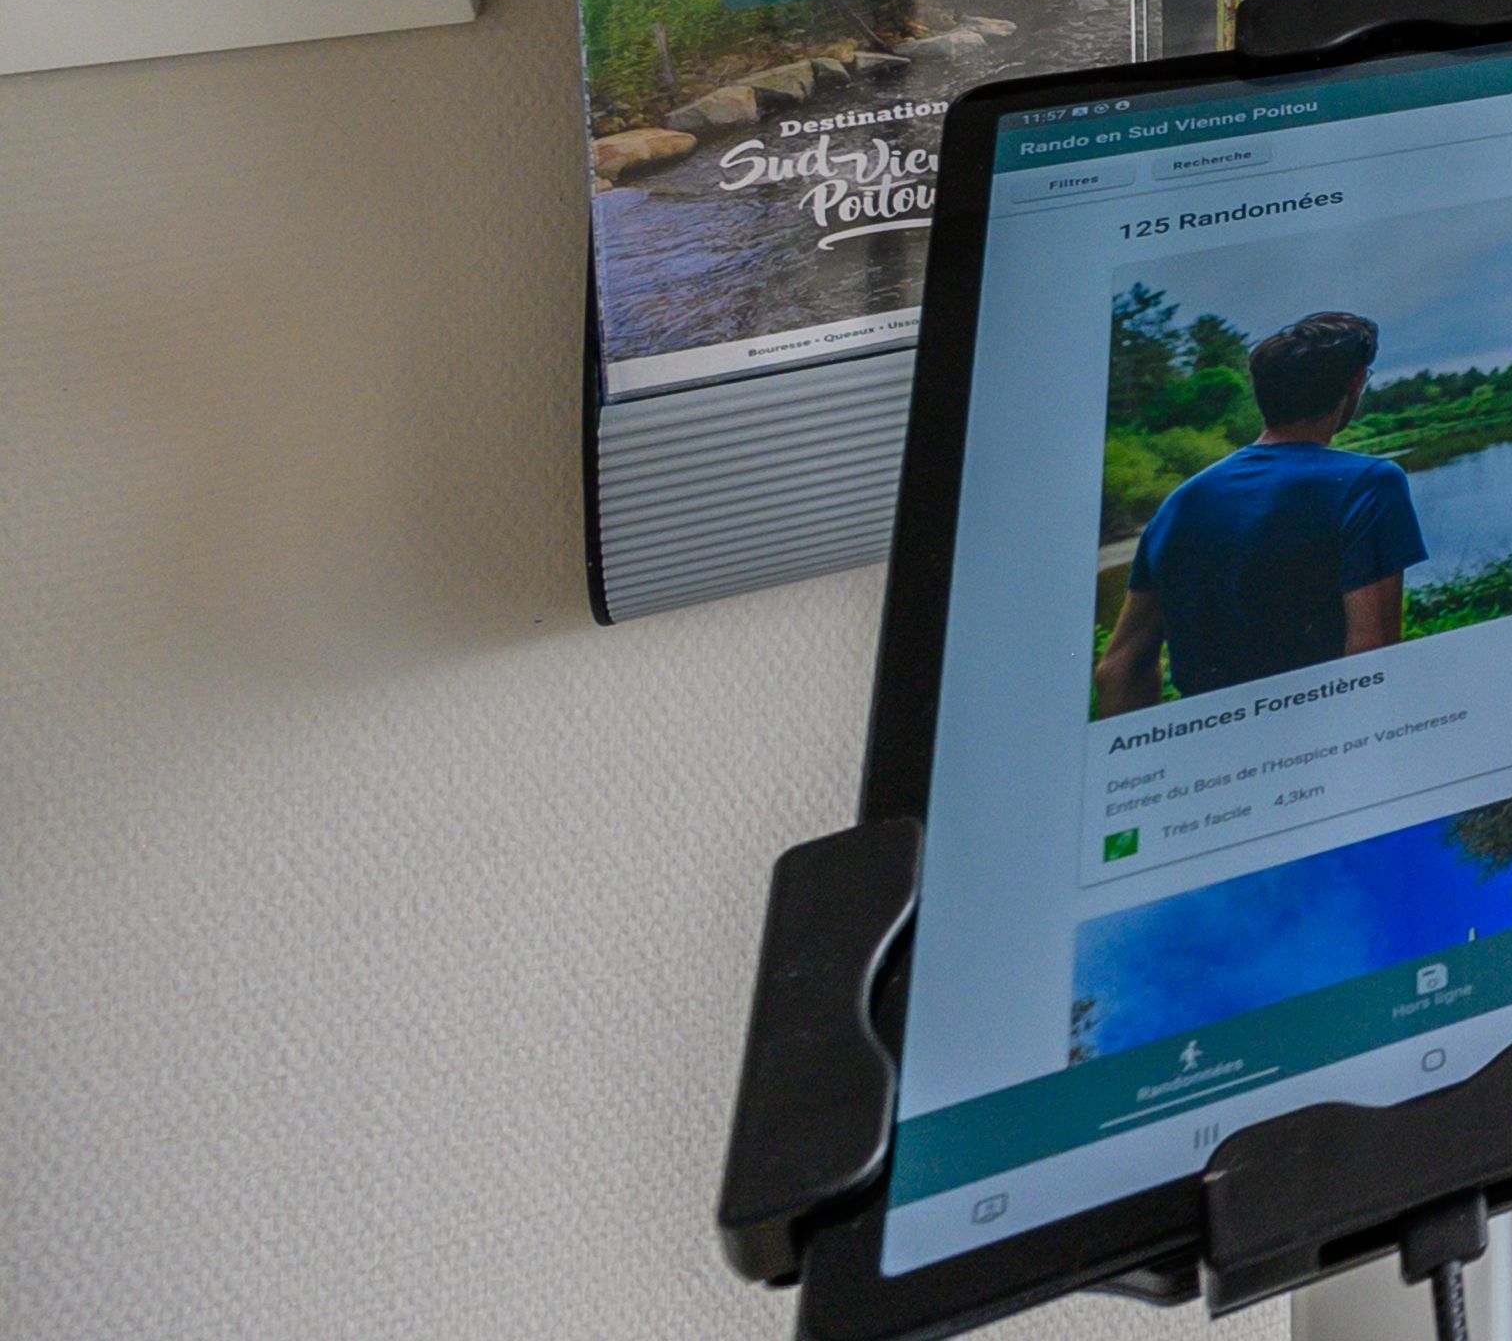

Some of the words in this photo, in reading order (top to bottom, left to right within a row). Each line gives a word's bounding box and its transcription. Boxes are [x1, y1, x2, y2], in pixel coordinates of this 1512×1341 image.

[780, 100, 949, 137] Destination
[1020, 135, 1090, 156] Rando
[1095, 130, 1122, 145] en
[1128, 121, 1169, 140] Sud
[1175, 113, 1247, 133] Vienne
[1252, 99, 1319, 121] Poitou
[1022, 109, 1067, 125] 11:57
[1173, 150, 1252, 171] Recherche
[1049, 173, 1099, 190] Filtres
[799, 174, 936, 227] Poitou
[1120, 217, 1170, 240] 125
[1179, 190, 1344, 232] Randonnées
[1108, 706, 1246, 754] Ambiances
[1254, 671, 1386, 716] Forestières
[1105, 791, 1163, 818] Entrée
[1167, 786, 1191, 803] du
[1194, 774, 1233, 795] Bois
[1236, 766, 1259, 782] de
[1262, 742, 1339, 775] l'Hospice
[1343, 734, 1371, 755] par
[1374, 707, 1469, 744] Vacheresse
[1106, 767, 1167, 795] Départ
[1273, 783, 1326, 809] 4,3km
[1161, 819, 1200, 840] Très
[1204, 803, 1253, 829] facile
